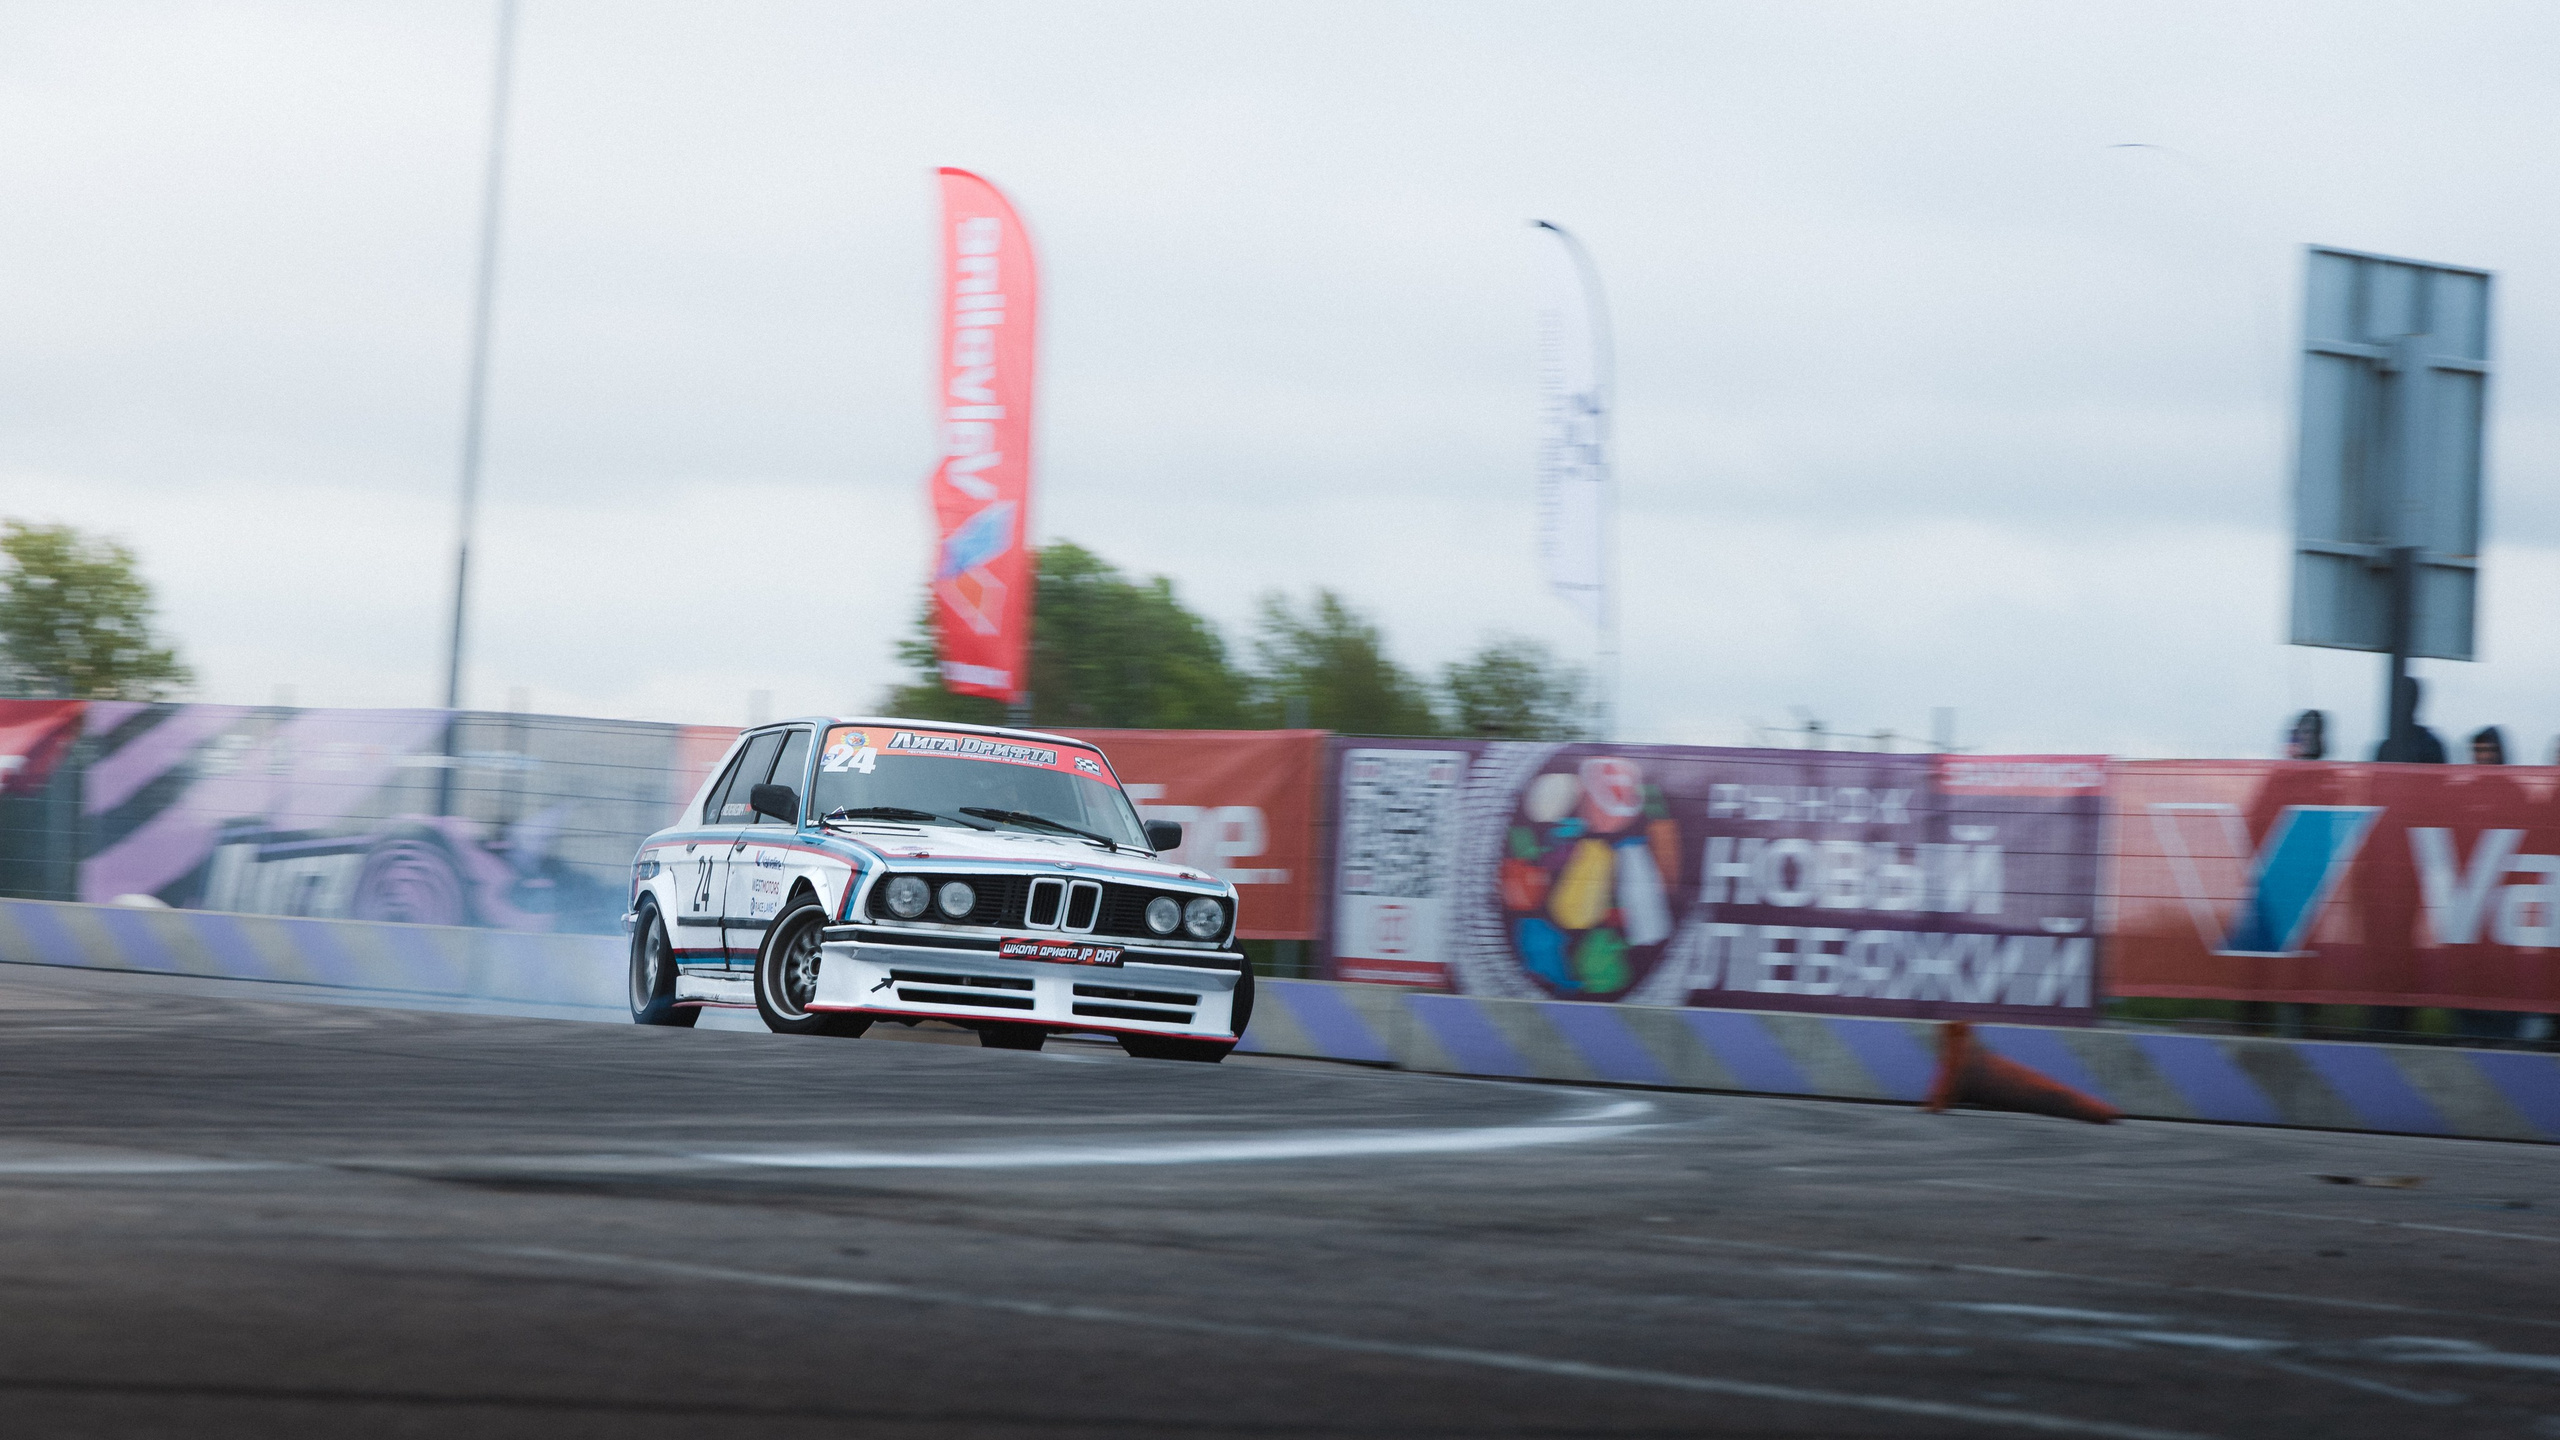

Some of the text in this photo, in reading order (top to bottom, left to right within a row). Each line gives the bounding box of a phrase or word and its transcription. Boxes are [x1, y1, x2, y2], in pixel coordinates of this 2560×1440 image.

[823, 743, 878, 775] 24
[693, 855, 713, 912] 24
[1701, 825, 2003, 914] НОВЫЙ
[1003, 943, 1121, 963] ШКОЛА ДРИФТА JP DAY
[1685, 917, 2095, 1008] ЛЕБЯЖИЙ
